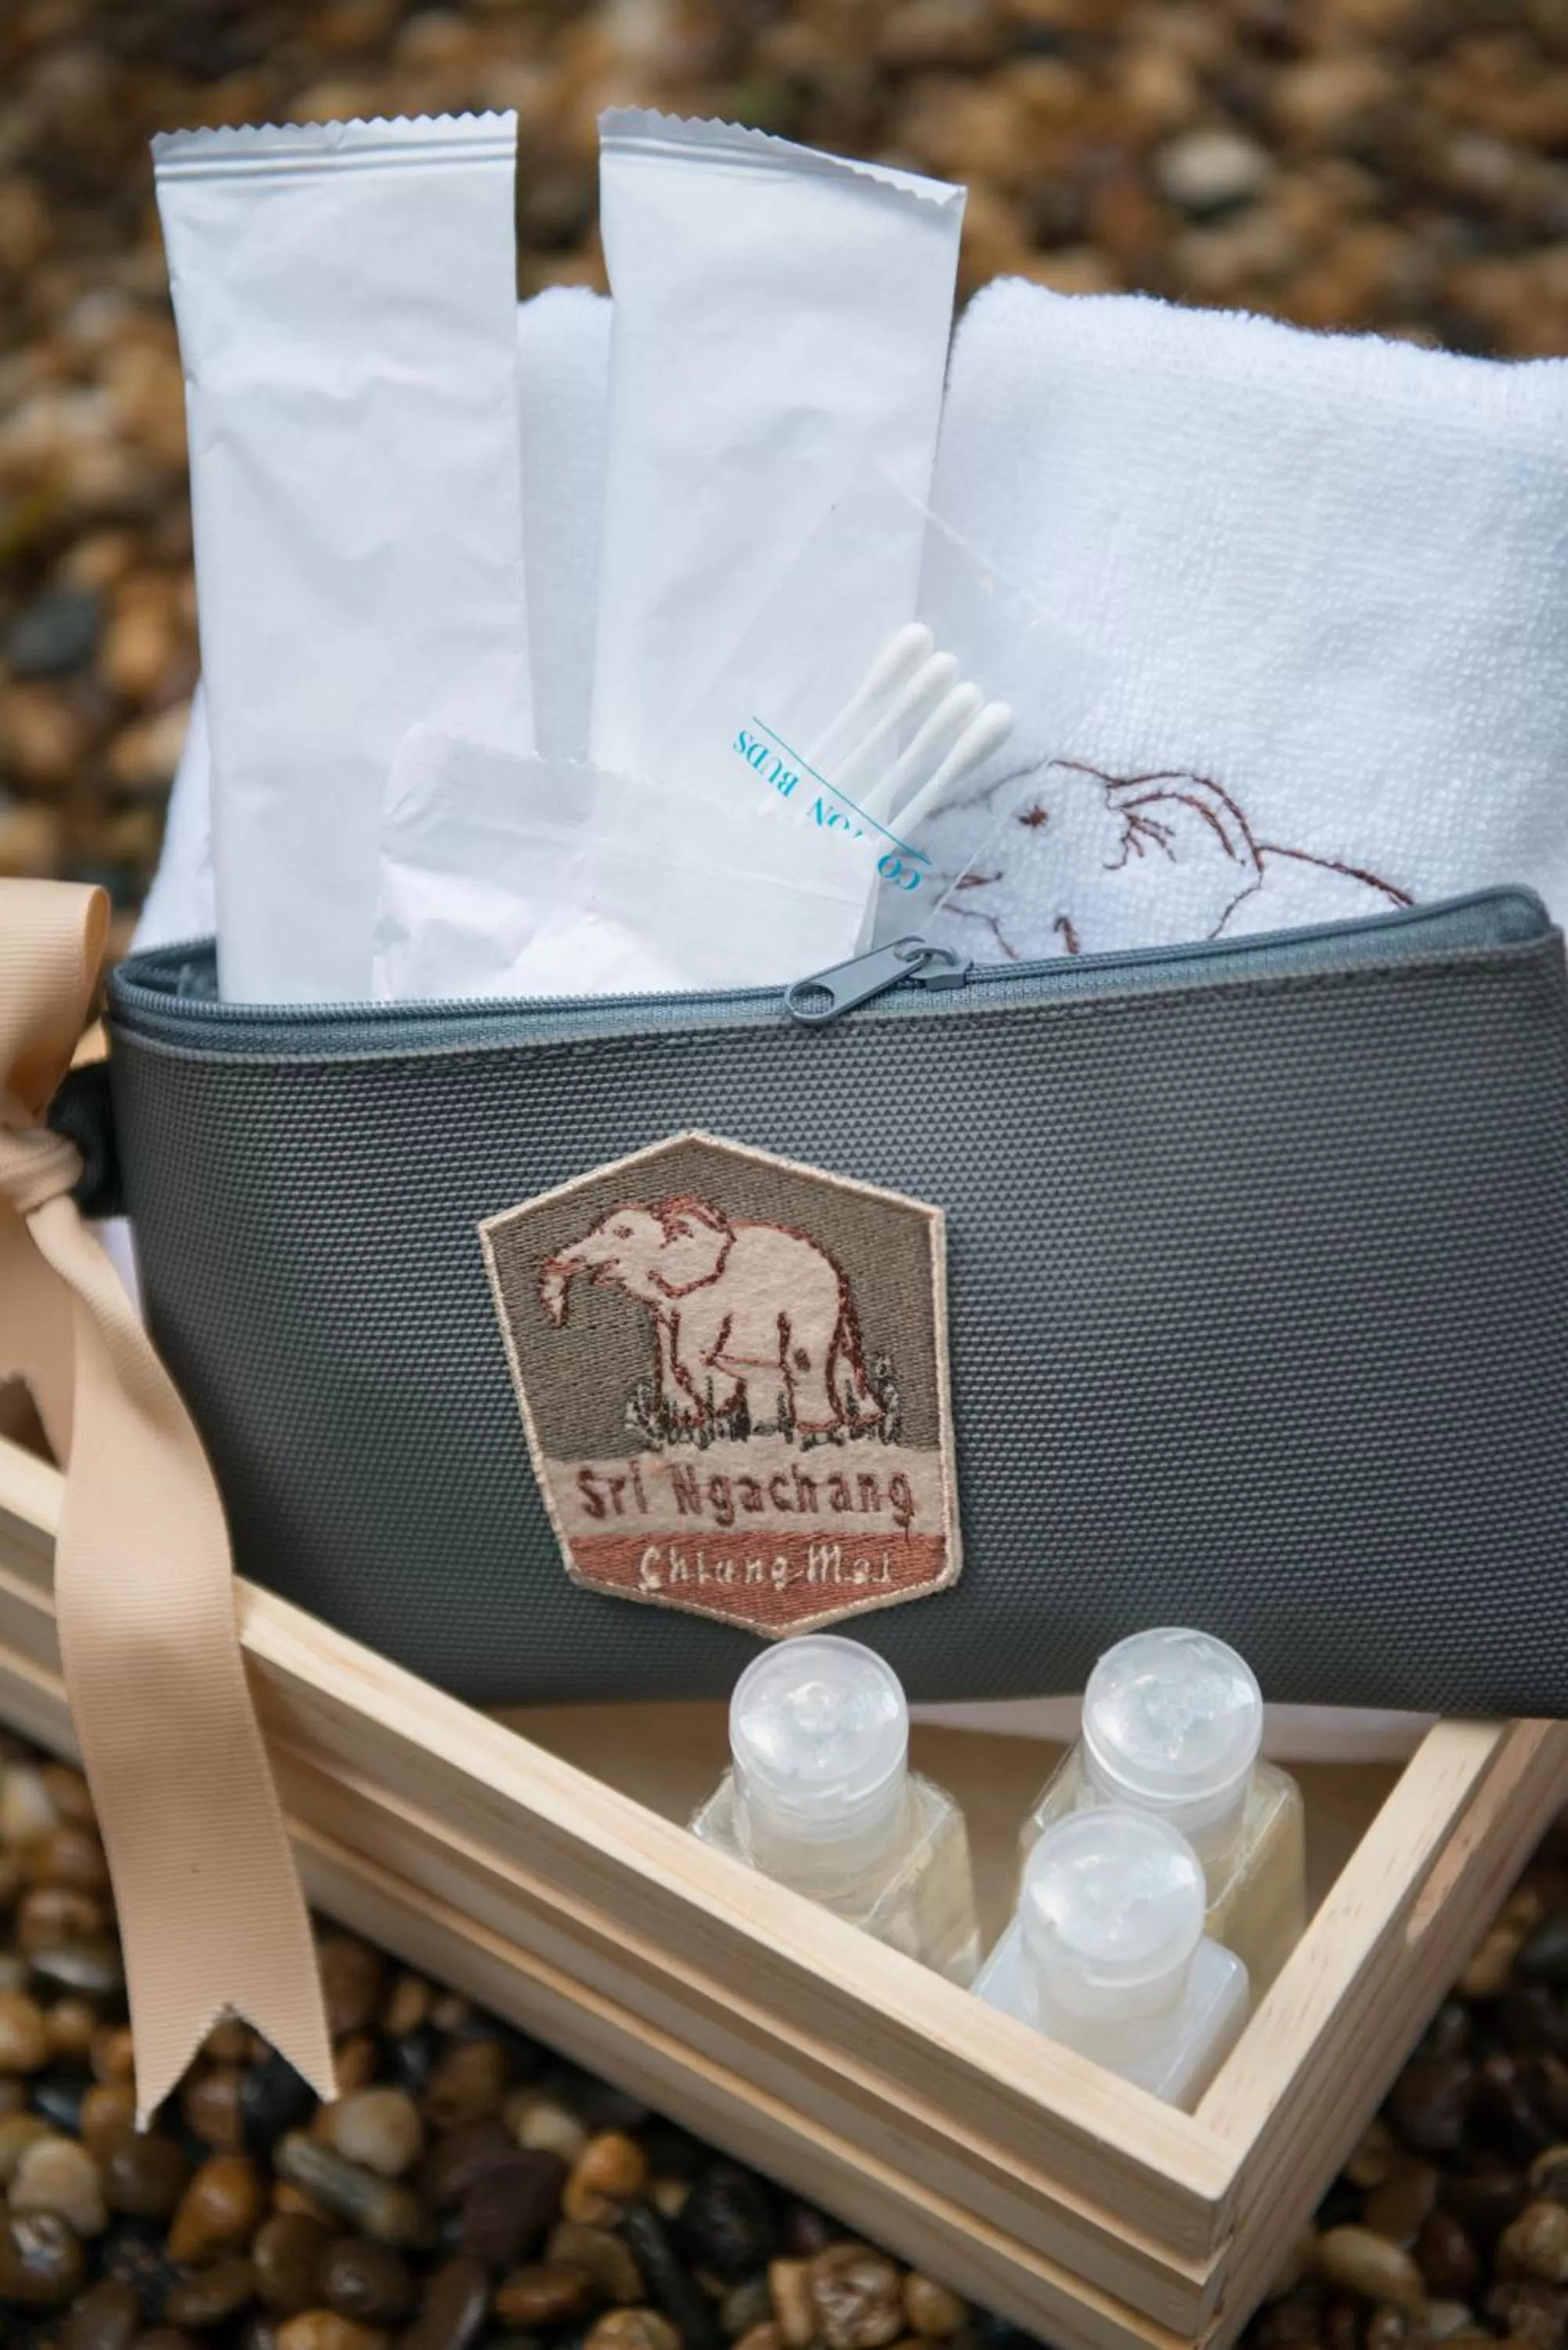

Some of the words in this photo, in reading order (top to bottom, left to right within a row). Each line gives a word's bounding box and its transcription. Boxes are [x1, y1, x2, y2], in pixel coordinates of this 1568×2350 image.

[732, 729, 800, 797] BUDS
[807, 796, 922, 891] COON
[576, 1459, 649, 1520] Sri
[667, 1462, 914, 1528] Ngachang
[638, 1544, 789, 1591] Chiang
[807, 1542, 891, 1584] Mai
